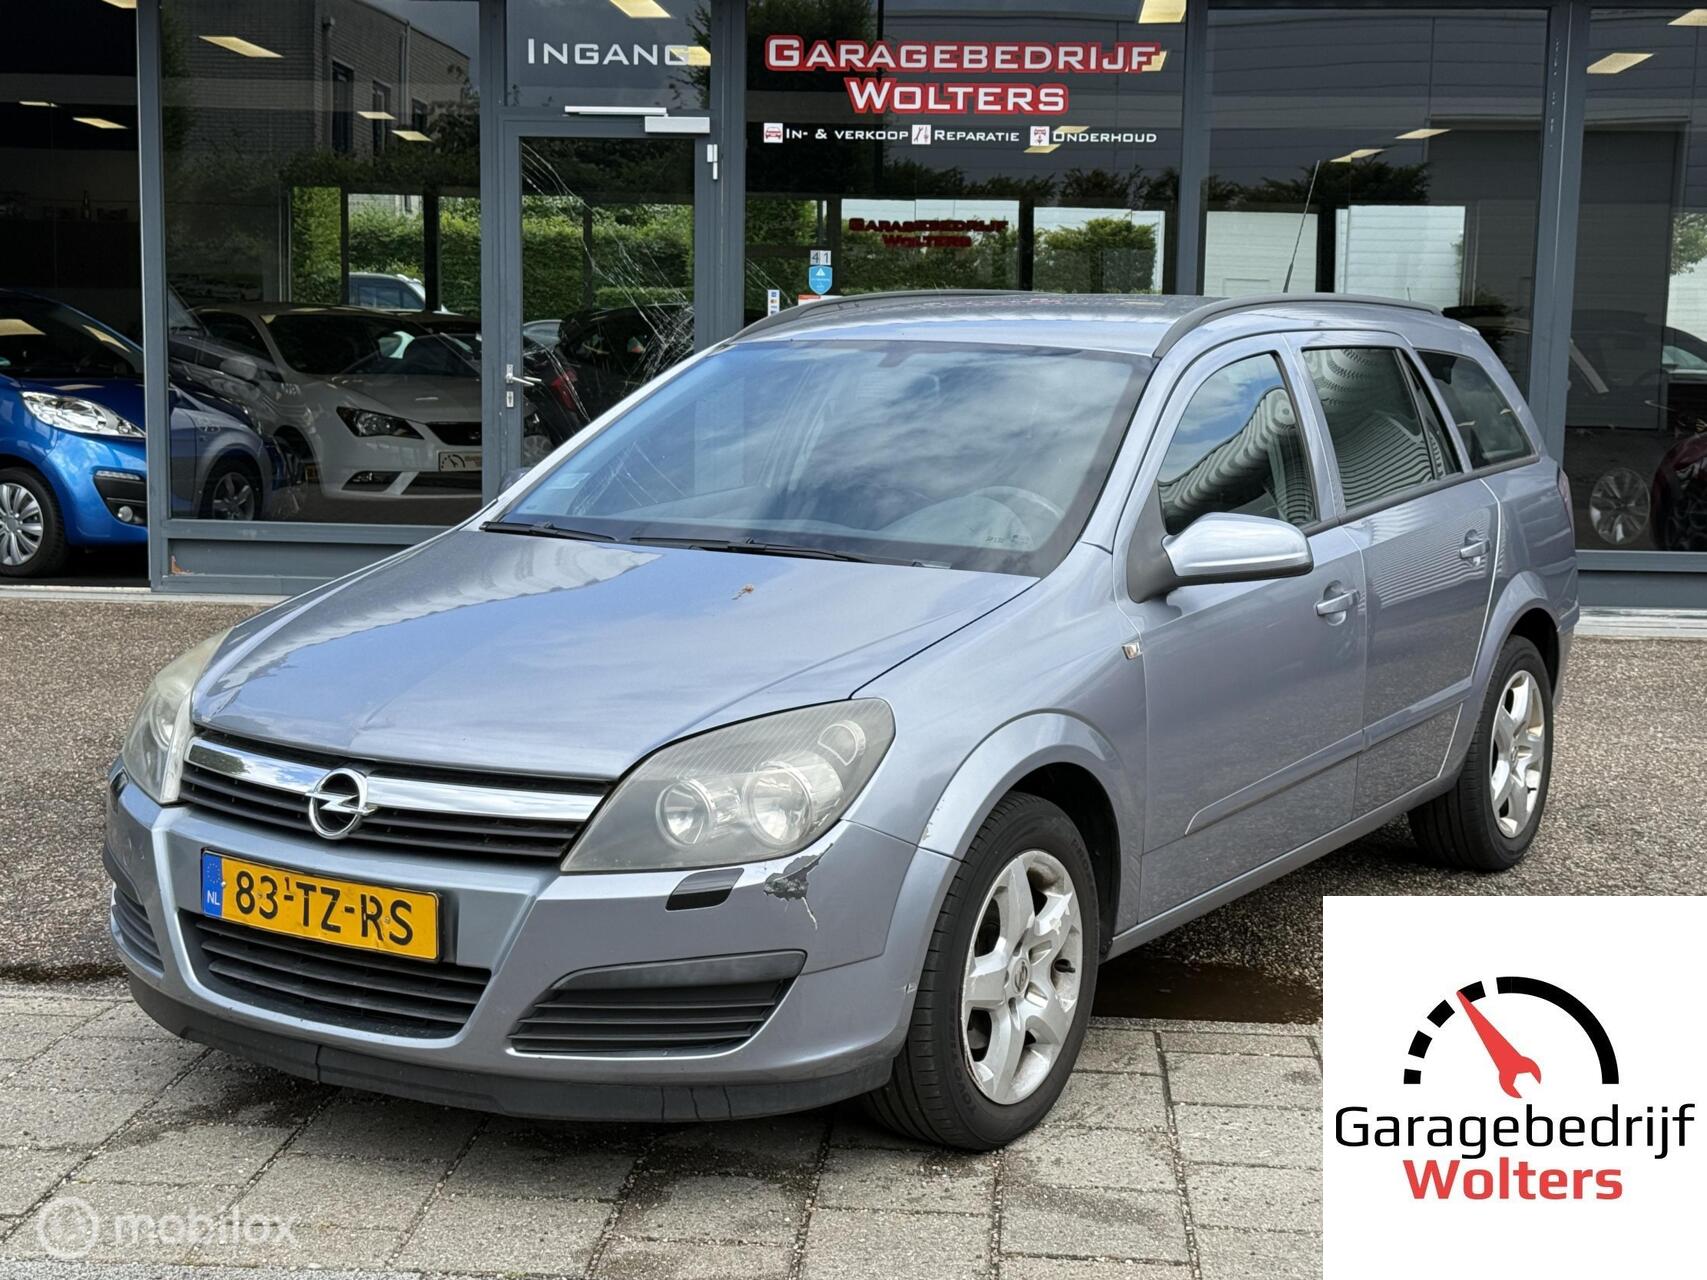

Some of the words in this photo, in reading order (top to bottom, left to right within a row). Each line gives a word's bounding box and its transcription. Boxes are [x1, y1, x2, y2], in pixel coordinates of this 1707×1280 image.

[766, 36, 1160, 72] GARAGEBEDRIJF
[844, 77, 1069, 114] WOLTERS
[785, 128, 809, 140] IN-
[815, 128, 828, 140] &
[834, 129, 909, 141] VERKOOP
[934, 129, 1020, 142] REPARATIE
[1052, 131, 1157, 144] ONDERHOUD
[811, 251, 830, 264] 41
[206, 891, 221, 906] NL
